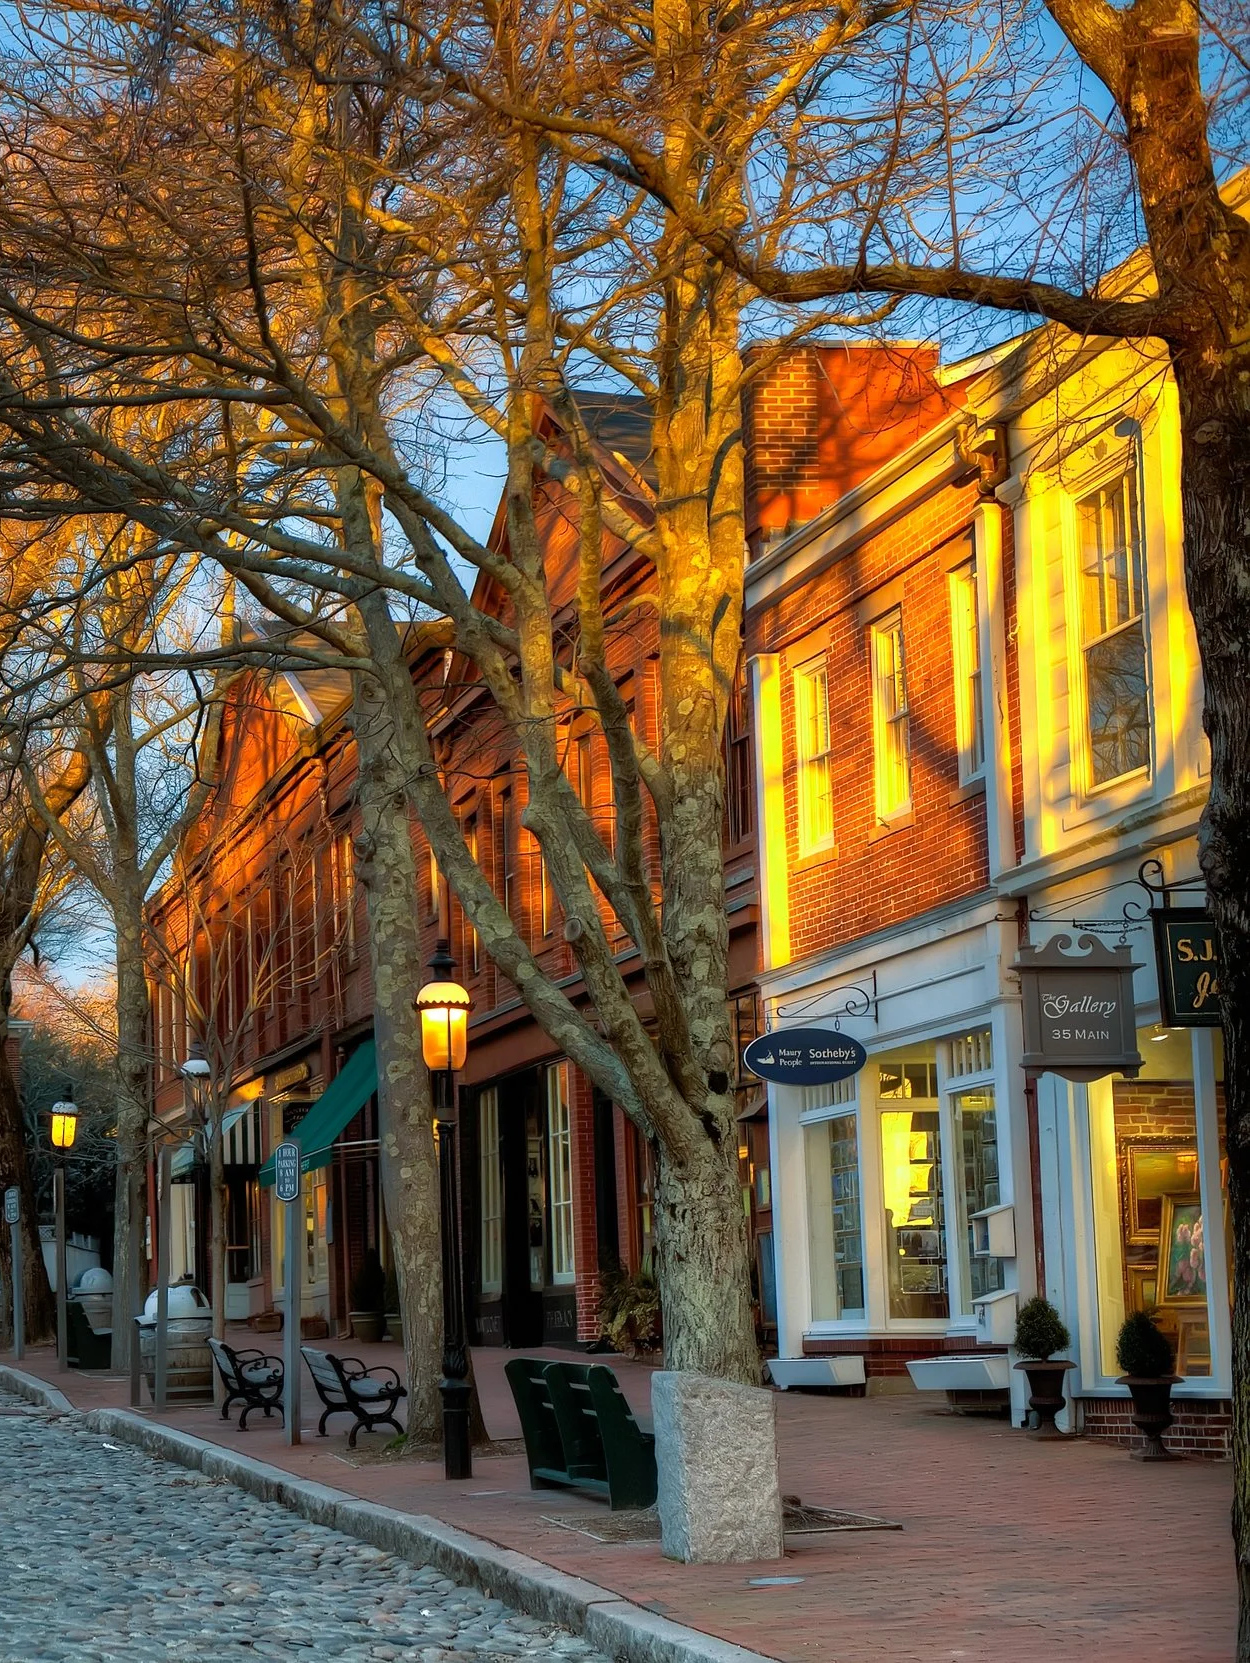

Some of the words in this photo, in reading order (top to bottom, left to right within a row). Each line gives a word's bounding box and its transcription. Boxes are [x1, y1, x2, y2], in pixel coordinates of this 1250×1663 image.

[1177, 939, 1218, 961] S.J.
[1042, 993, 1057, 1001] The
[1043, 994, 1116, 1019] Gallery
[1052, 1029, 1071, 1040] 35
[1075, 1029, 1110, 1040] MAIN
[778, 1048, 802, 1057] Maury
[809, 1047, 856, 1060] Sotheby's
[779, 1058, 803, 1068] People
[282, 1147, 296, 1158] HOUR
[277, 1159, 297, 1168] PARKING
[284, 1168, 295, 1177] AM
[285, 1183, 295, 1192] PM
